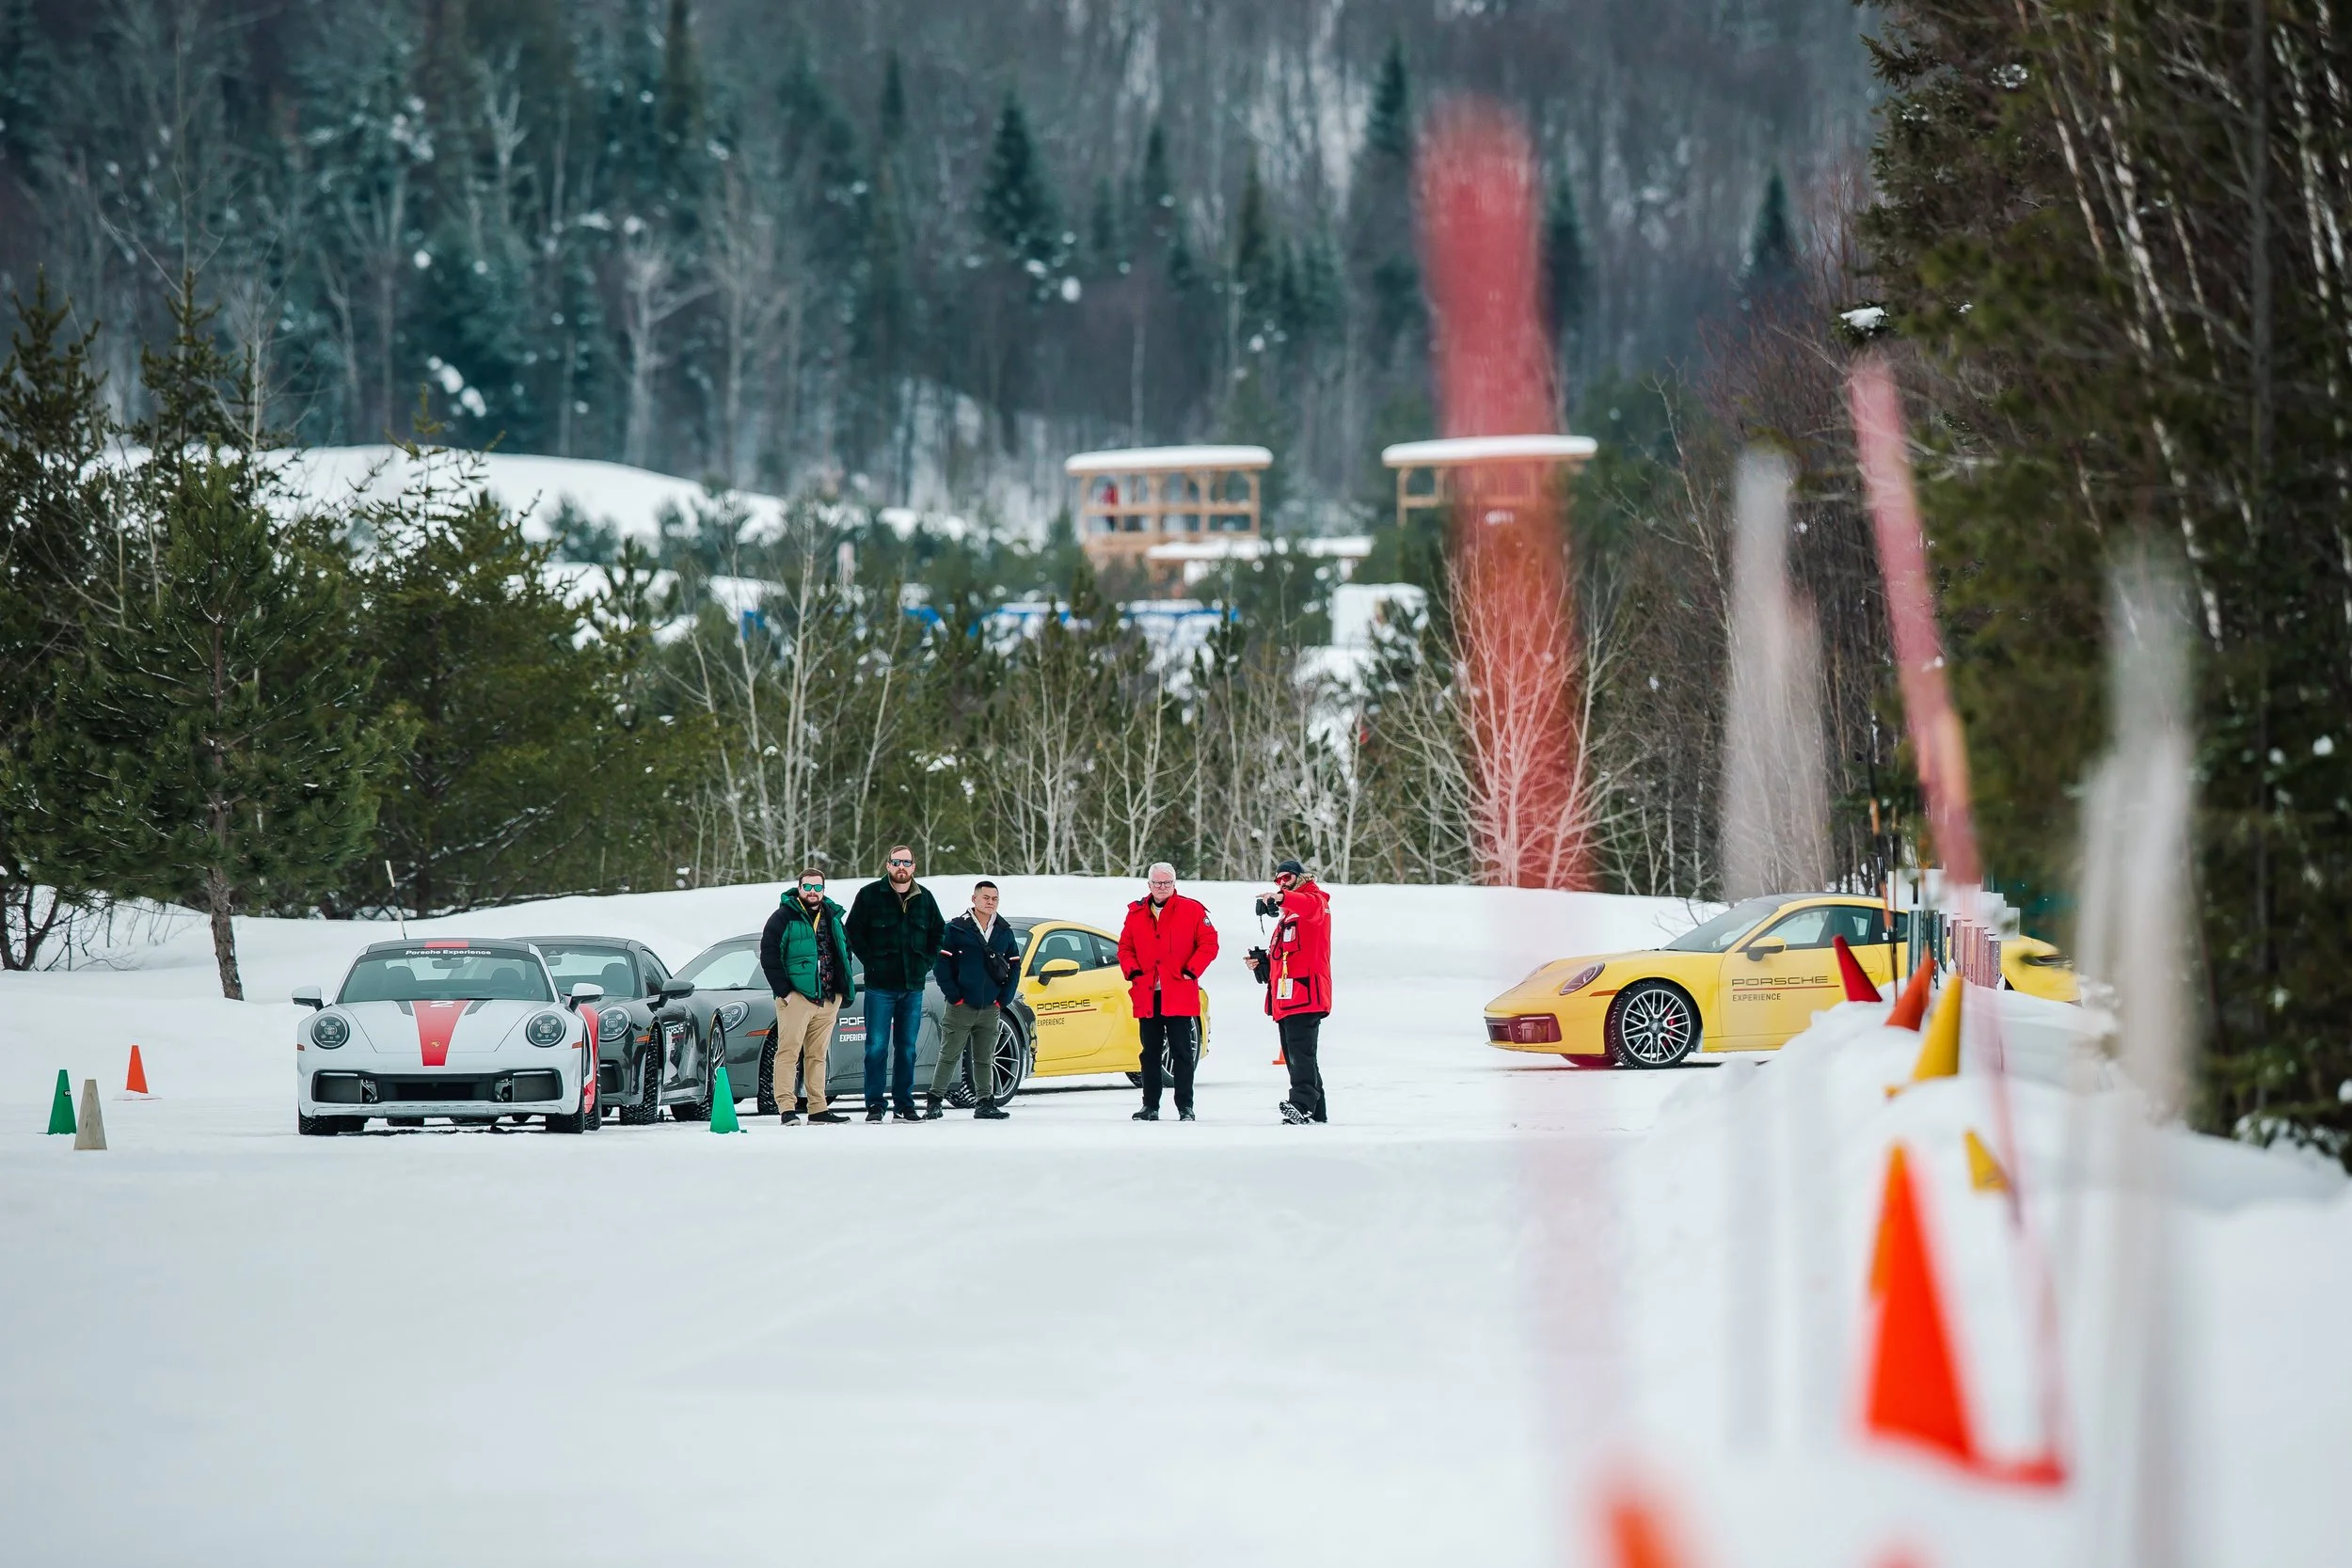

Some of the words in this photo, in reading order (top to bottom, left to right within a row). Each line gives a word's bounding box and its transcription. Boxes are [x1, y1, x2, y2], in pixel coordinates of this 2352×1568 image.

[1732, 975, 1829, 986] PORSCHE
[1732, 993, 1782, 1002] EXPERIENCE
[1037, 999, 1091, 1011] PORSCHE
[1037, 1018, 1065, 1026] EXPERIENCE
[839, 1032, 867, 1042] EXPERIEN
